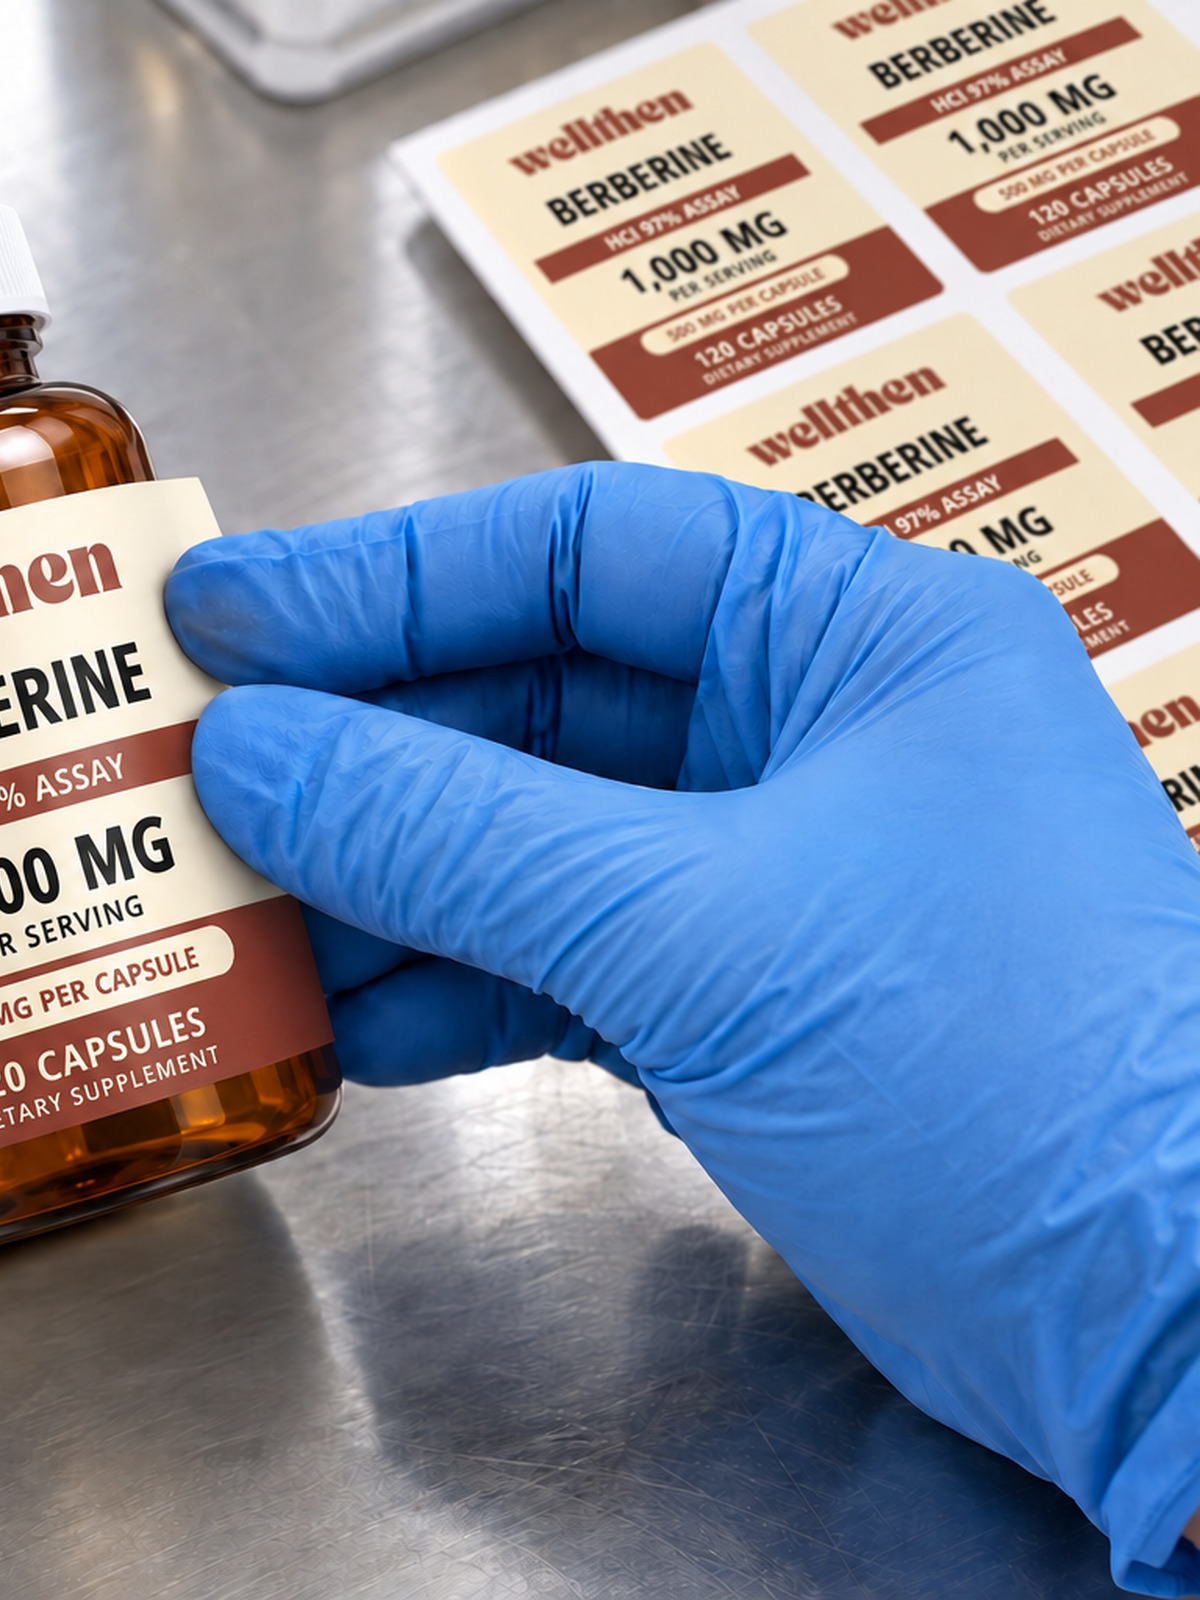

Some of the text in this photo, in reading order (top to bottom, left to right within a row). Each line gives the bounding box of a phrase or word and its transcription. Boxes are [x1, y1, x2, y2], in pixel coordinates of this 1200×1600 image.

[868, 0, 1057, 90] BERBERINE
[508, 91, 693, 176] wellthen
[545, 132, 733, 228] BERBERINE
[642, 211, 682, 237] 97%
[684, 186, 740, 218] ASSAY
[620, 210, 788, 298] 1,000 MG
[668, 250, 778, 303] PER SERVING
[694, 295, 843, 369] 120 CAPSULES
[696, 309, 726, 330] MG
[727, 296, 758, 318] PER
[758, 268, 826, 305] CAPSULE
[746, 366, 947, 468] wellthen
[895, 474, 1002, 534] 97% ASSAY
[979, 506, 1054, 555] MG
[36, 753, 126, 803] ASSAY
[75, 815, 176, 891] MG
[25, 895, 144, 948] SERVING
[39, 981, 90, 1018] PER
[94, 946, 200, 997] CAPSULE
[37, 1006, 207, 1084] CAPSULES
[71, 1045, 220, 1107] SUPPLEMENT
